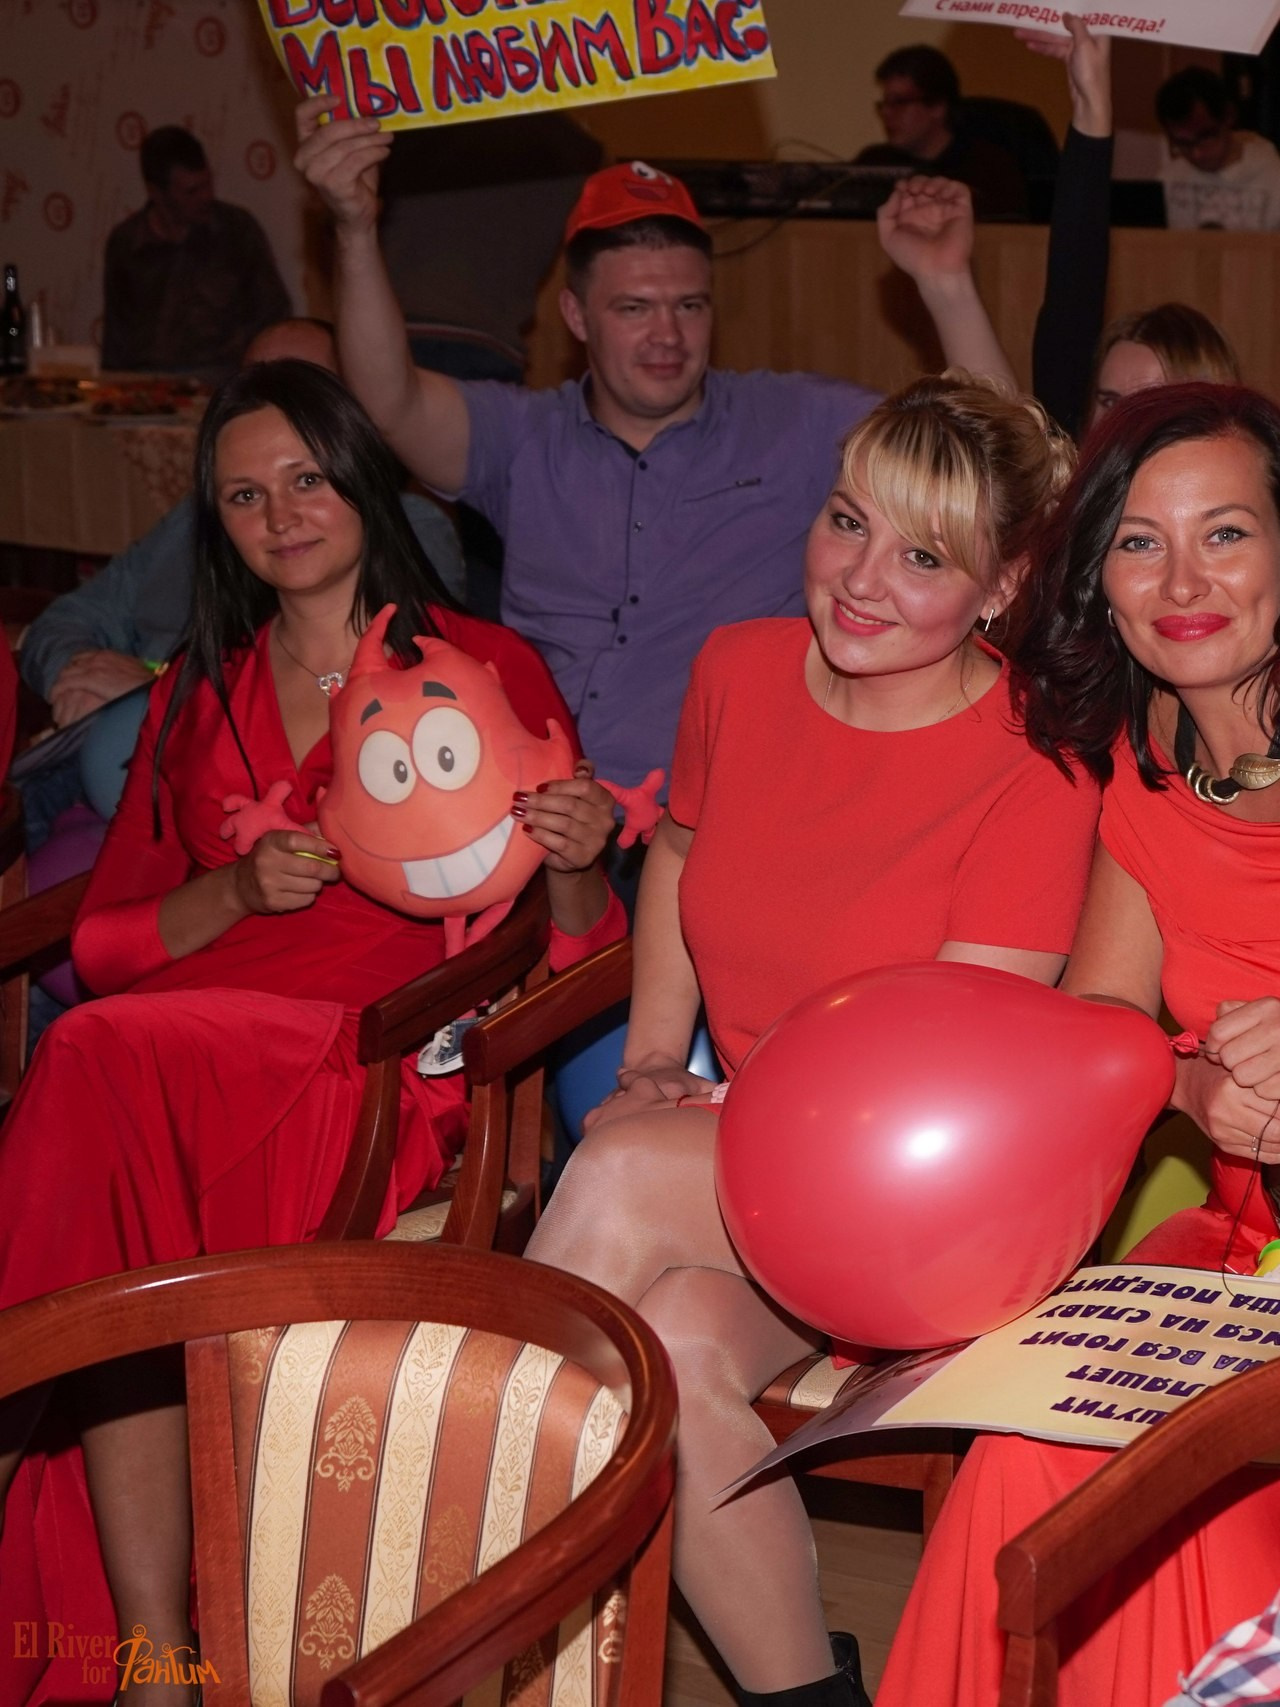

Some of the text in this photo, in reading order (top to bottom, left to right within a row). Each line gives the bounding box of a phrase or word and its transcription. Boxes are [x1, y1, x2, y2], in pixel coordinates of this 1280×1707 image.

[949, 1, 995, 12] нами
[997, 2, 1060, 24] впредь
[1035, 1304, 1151, 1323] СЛАВУ
[1159, 1314, 1210, 1333] НА
[1019, 1331, 1130, 1352] ГОРИТ
[1131, 1342, 1206, 1366] ВСЯ
[1065, 1365, 1213, 1397] ЛЯШЕТ
